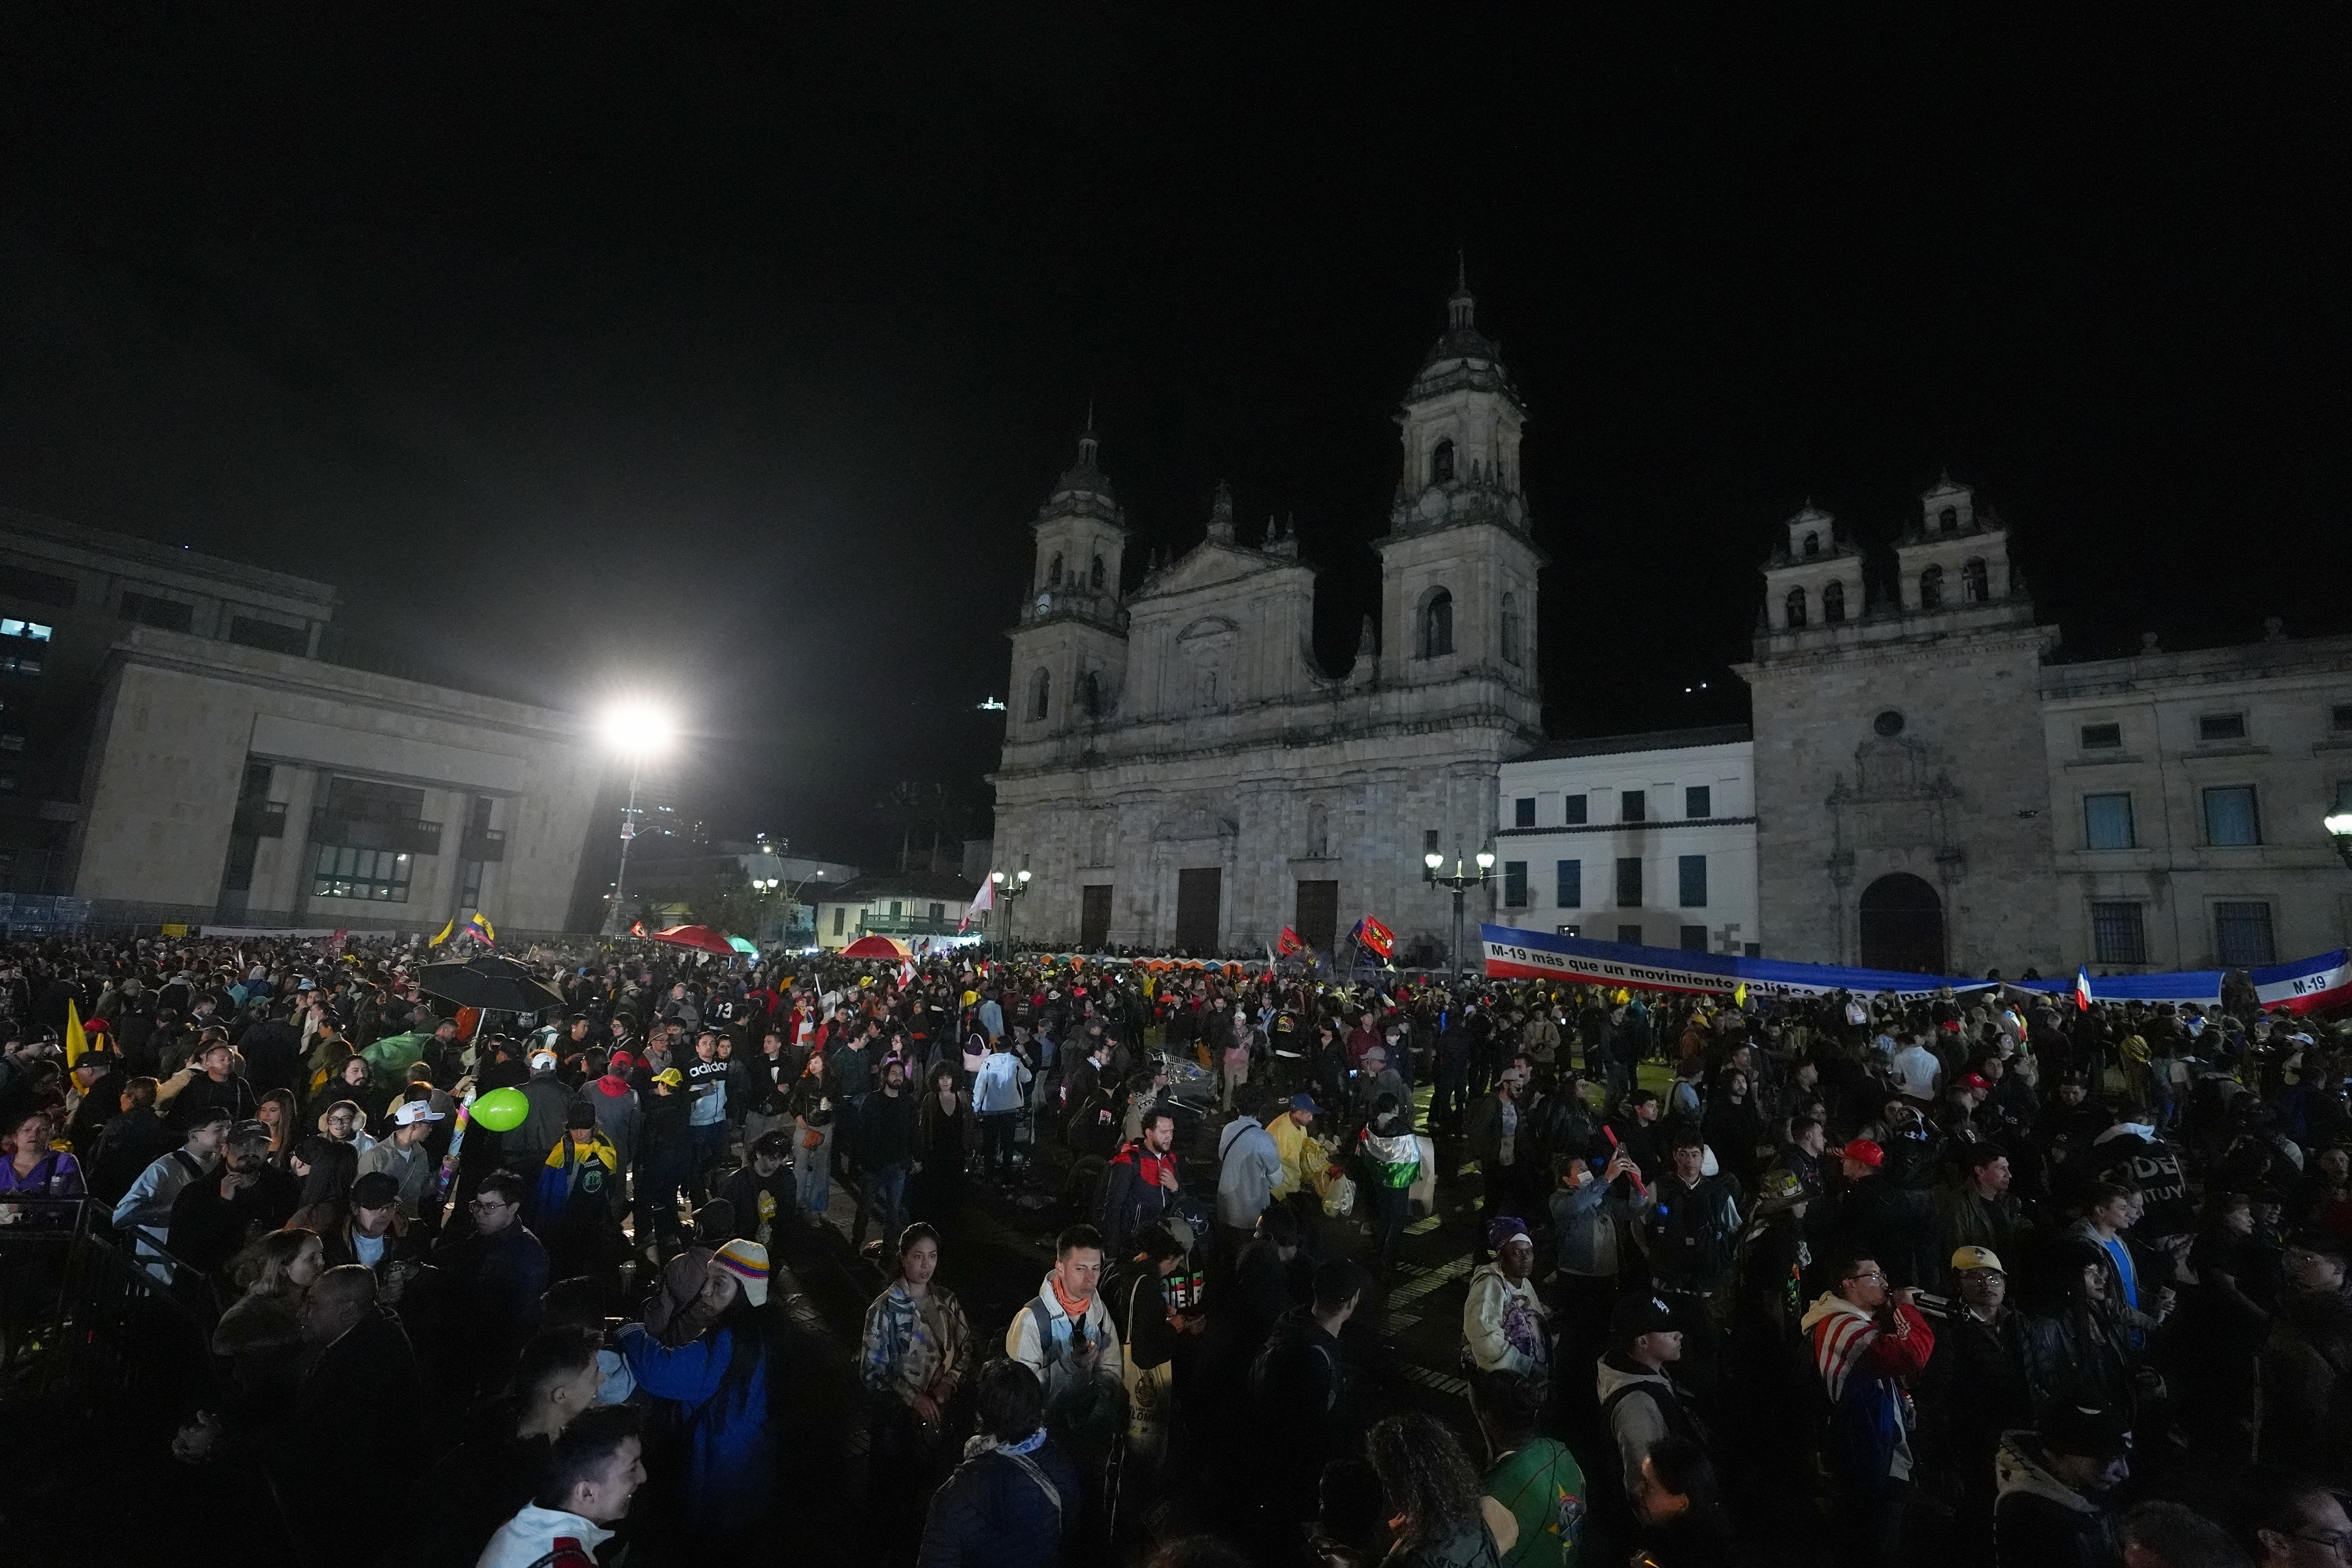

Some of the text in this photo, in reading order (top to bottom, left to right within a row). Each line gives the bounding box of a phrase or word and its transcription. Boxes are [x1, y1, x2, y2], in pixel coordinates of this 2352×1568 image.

[1491, 944, 1526, 960] M-19
[1532, 953, 1564, 967] más
[1569, 959, 1599, 972] que
[1603, 964, 1625, 975] un
[1629, 968, 1735, 988] movimiento
[2293, 975, 2326, 994] M-19
[715, 1002, 732, 1019] 13
